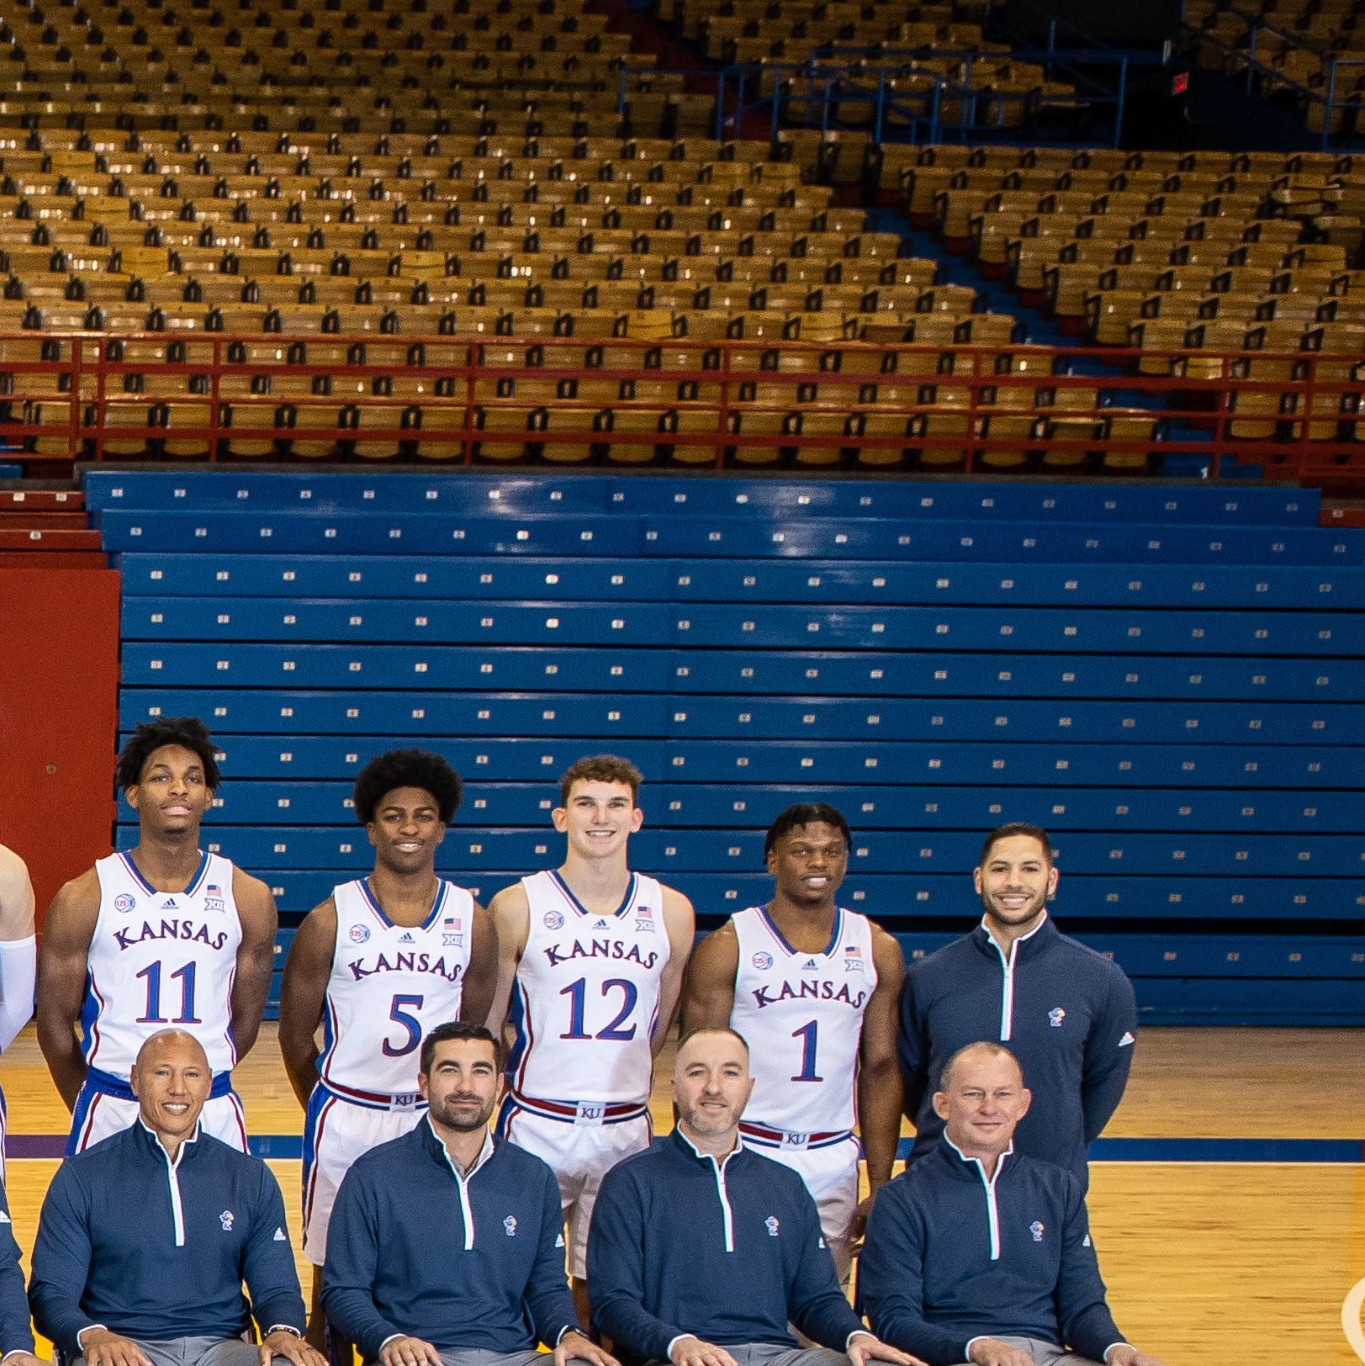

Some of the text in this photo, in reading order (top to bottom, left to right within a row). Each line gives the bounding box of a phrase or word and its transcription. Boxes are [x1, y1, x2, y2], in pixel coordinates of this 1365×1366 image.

[113, 919, 228, 950] KANSAS
[348, 951, 462, 981] KANSAS
[544, 939, 657, 969] KANSAS
[135, 960, 202, 1024] 11
[752, 980, 866, 1009] KANSAS
[559, 977, 638, 1041] 12
[382, 994, 424, 1057] 5
[790, 1019, 824, 1082] 1
[581, 1108, 601, 1120] KU
